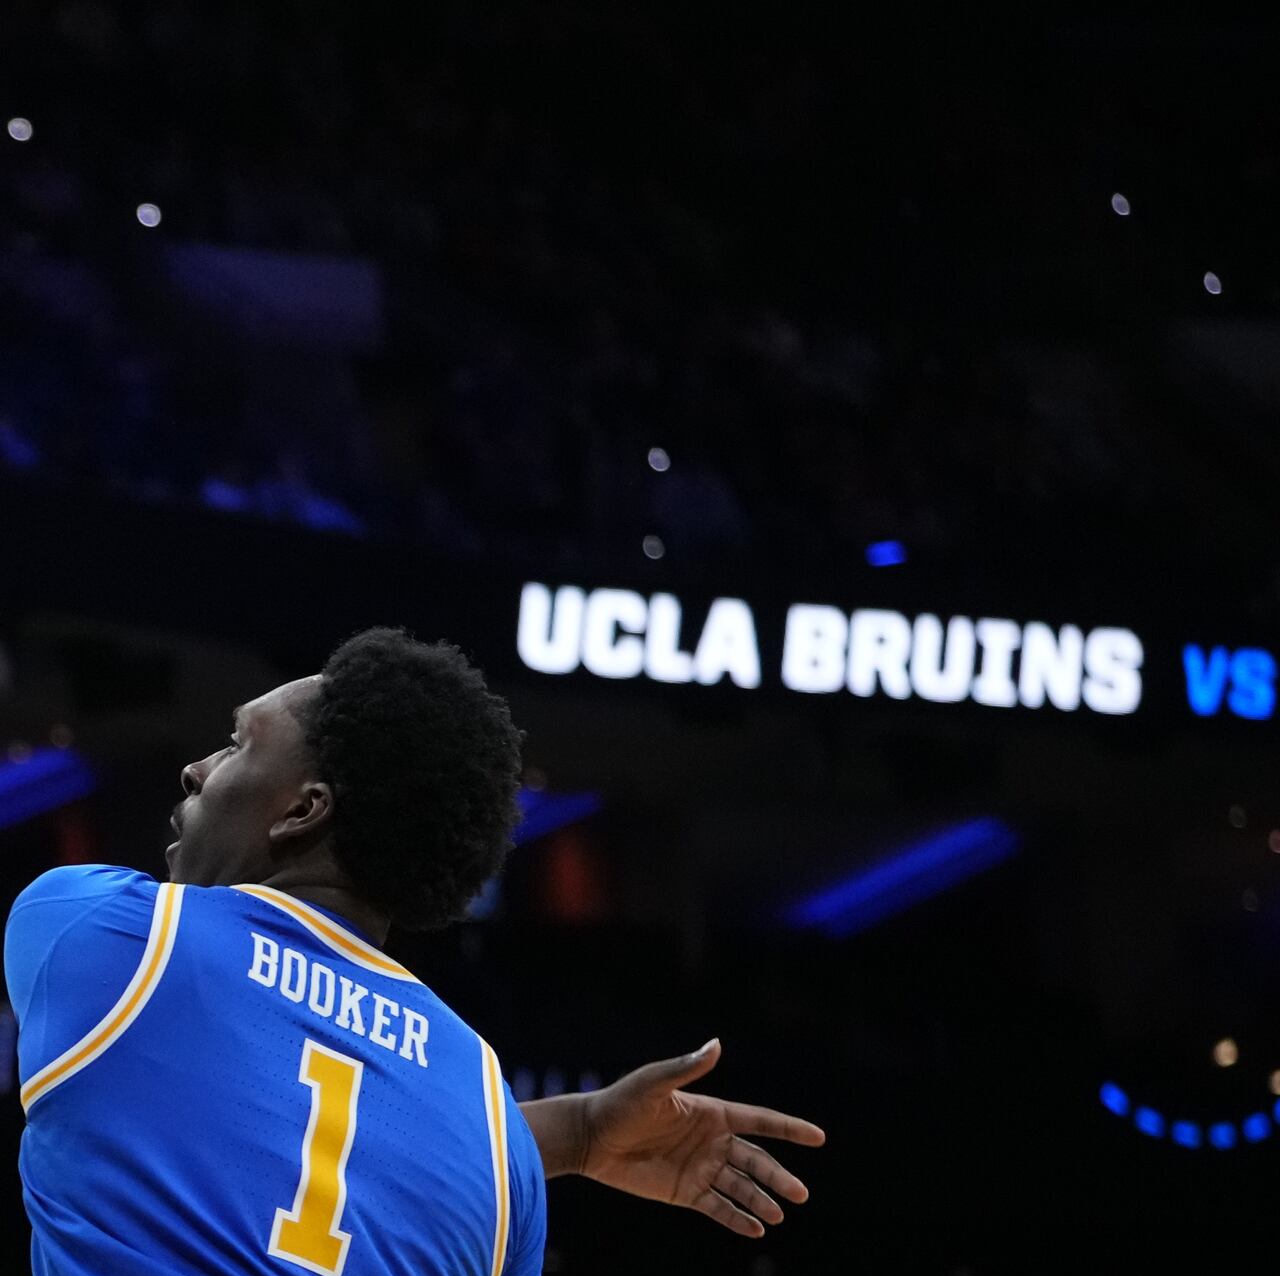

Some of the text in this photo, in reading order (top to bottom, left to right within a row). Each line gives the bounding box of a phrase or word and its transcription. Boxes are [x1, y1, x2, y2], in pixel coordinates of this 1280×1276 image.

[517, 582, 1275, 720] UCLA BRUINS VS
[247, 931, 429, 1068] BOOKER
